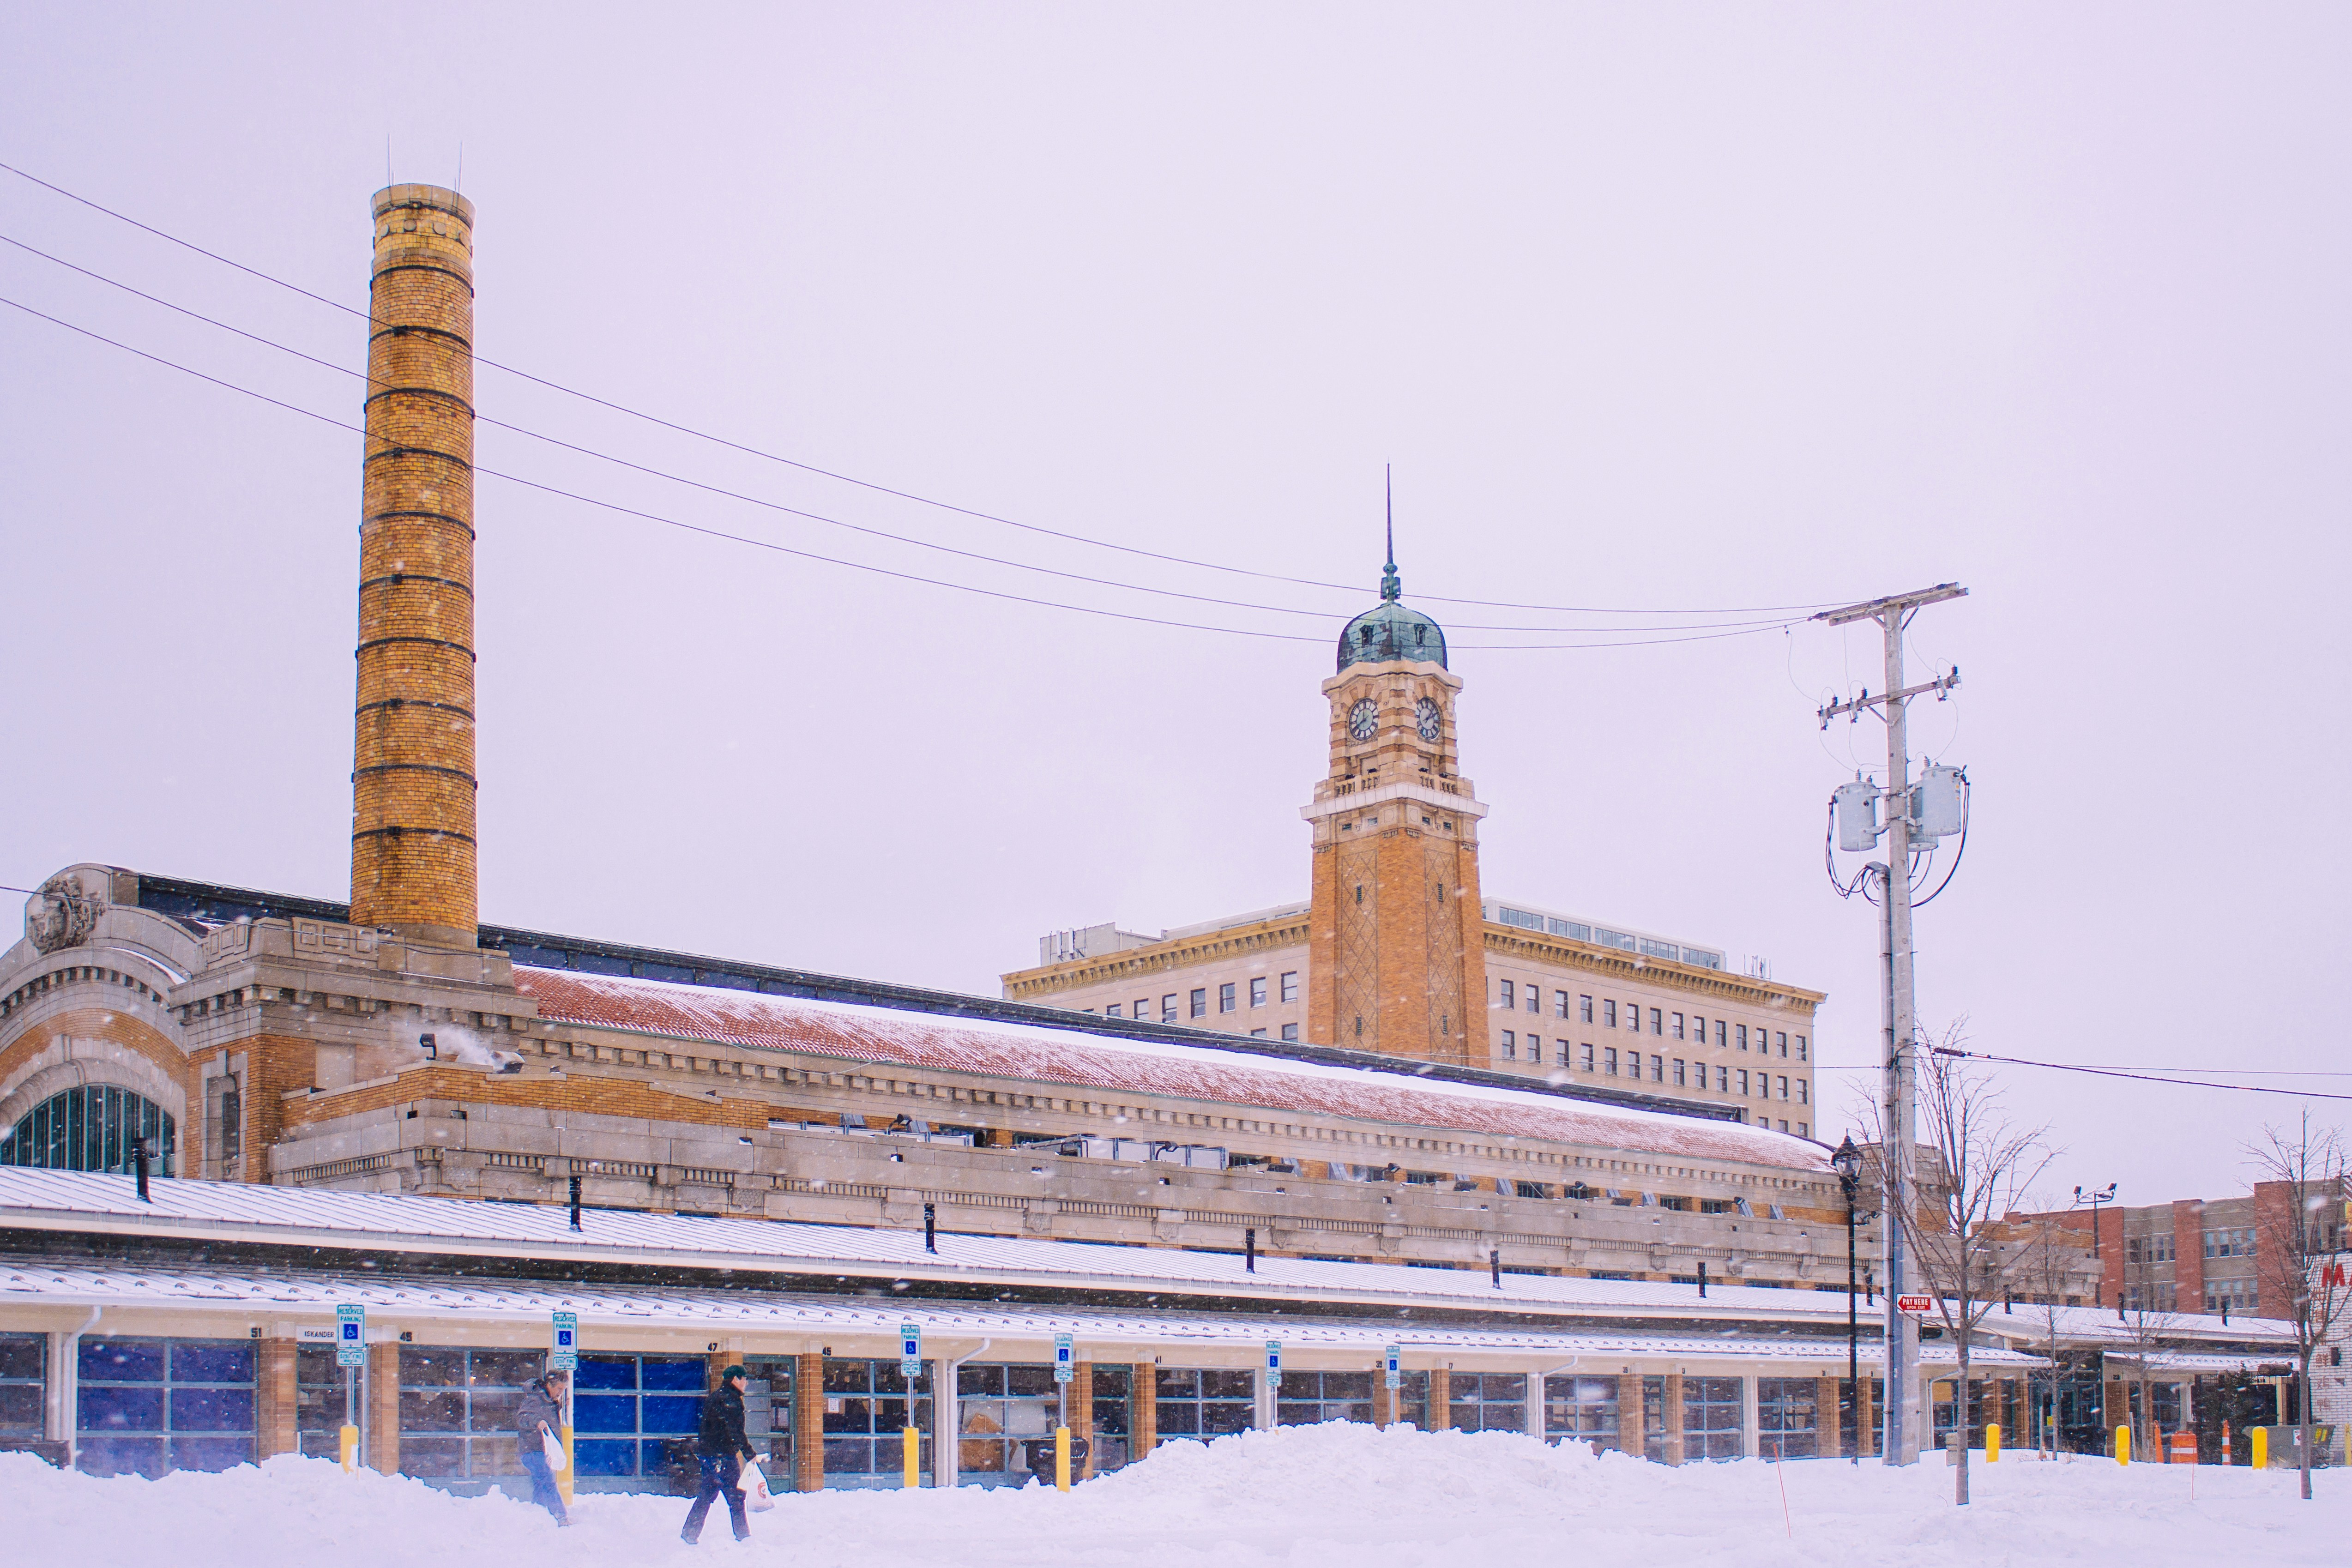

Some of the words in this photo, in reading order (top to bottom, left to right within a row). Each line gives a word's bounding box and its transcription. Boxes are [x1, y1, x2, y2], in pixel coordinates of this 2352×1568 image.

[2322, 1263, 2352, 1287] M
[251, 1327, 262, 1338] 51
[707, 1342, 718, 1351] 47
